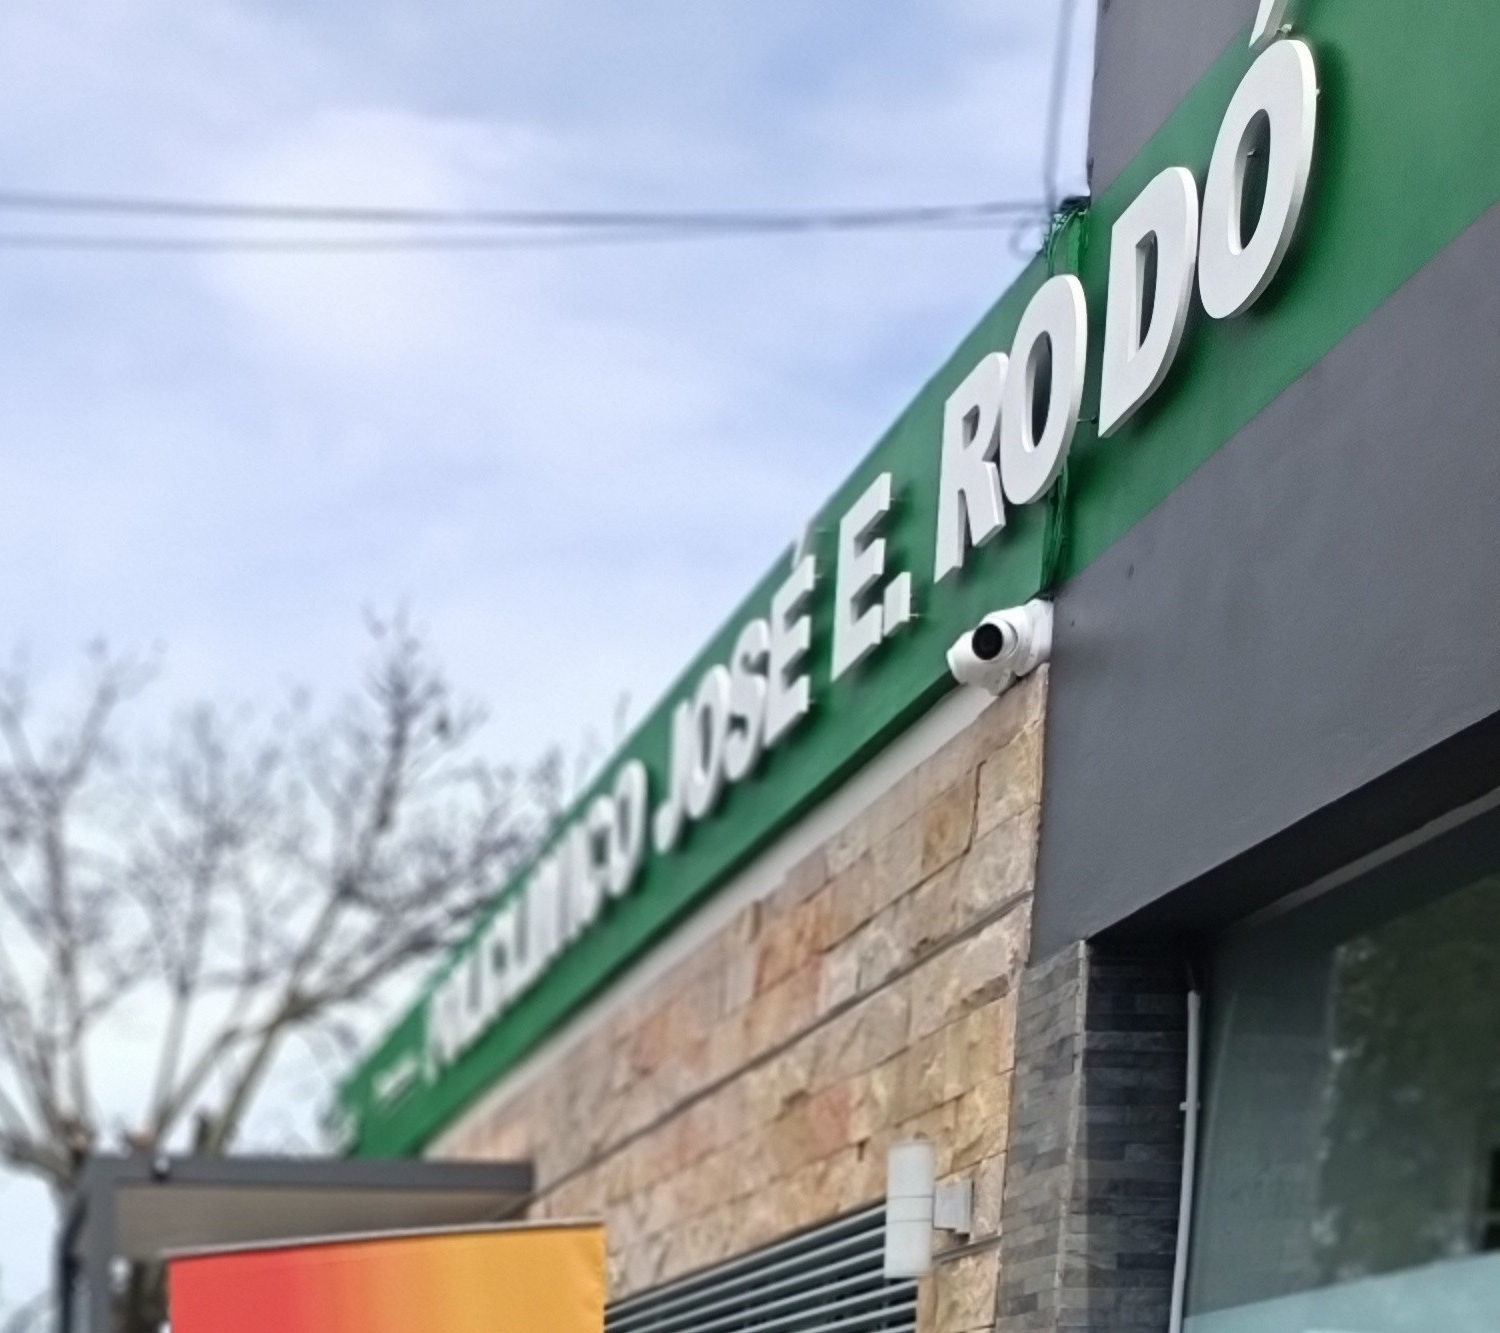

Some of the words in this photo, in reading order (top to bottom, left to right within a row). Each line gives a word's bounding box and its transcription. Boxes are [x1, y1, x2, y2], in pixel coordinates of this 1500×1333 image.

[654, 540, 815, 854] JOSÉ
[830, 474, 913, 683] E.
[934, 0, 1318, 583] RODÓ
